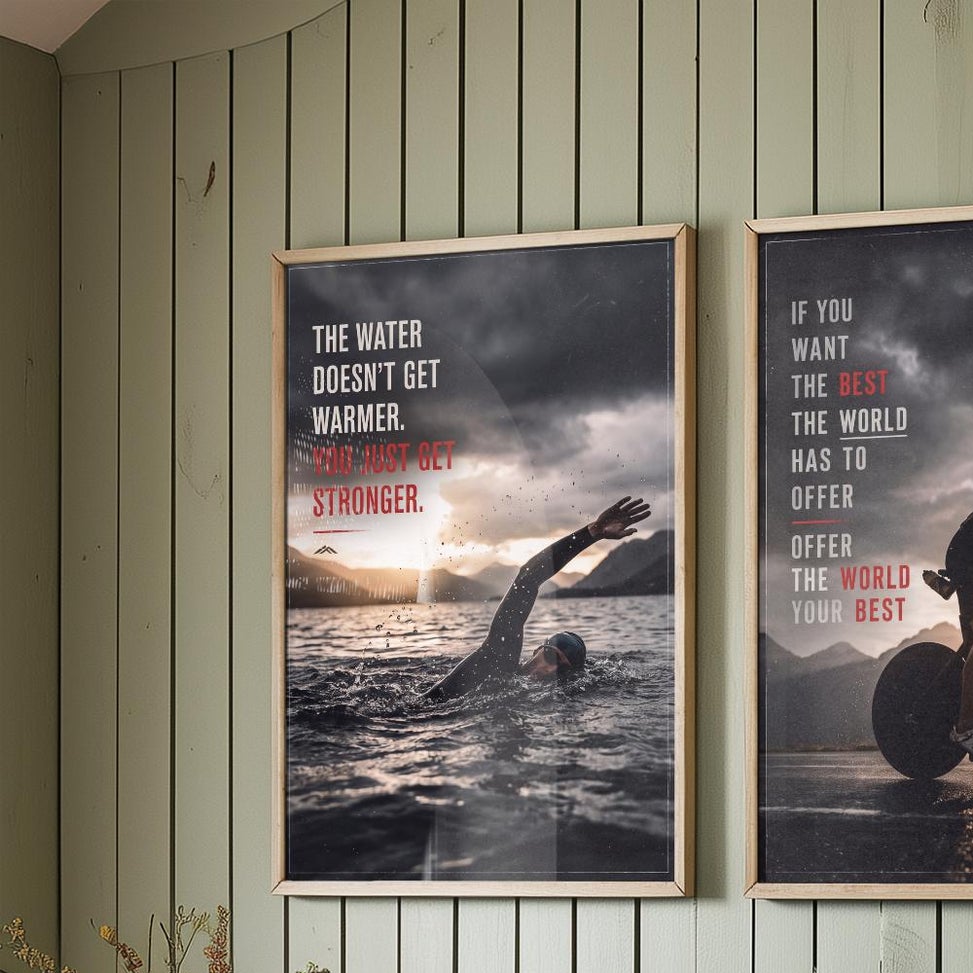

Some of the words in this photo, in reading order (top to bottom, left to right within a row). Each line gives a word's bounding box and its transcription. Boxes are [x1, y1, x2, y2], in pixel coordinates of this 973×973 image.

[791, 300, 808, 325] IF
[816, 298, 853, 324] YOU
[312, 324, 349, 354] THE
[355, 319, 423, 351] WATER
[791, 335, 849, 362] WANT
[312, 361, 396, 395] DOESN’T
[403, 358, 441, 390] GET
[791, 373, 828, 399] THE
[838, 368, 889, 397] BEST
[312, 402, 405, 435] WARMER.
[791, 410, 828, 436] THE
[839, 406, 908, 434] WORLD
[312, 445, 353, 477] YOU
[360, 443, 411, 475] JUST
[417, 440, 456, 471] GET
[791, 447, 831, 473] HAS
[842, 446, 867, 471] TO
[312, 484, 423, 518] STRONGER.
[791, 483, 854, 511] OFFER
[791, 533, 852, 559] OFFER
[791, 566, 829, 592] THE
[840, 564, 911, 591] WORLD
[791, 599, 843, 625] YOUR
[855, 597, 906, 623] BEST
